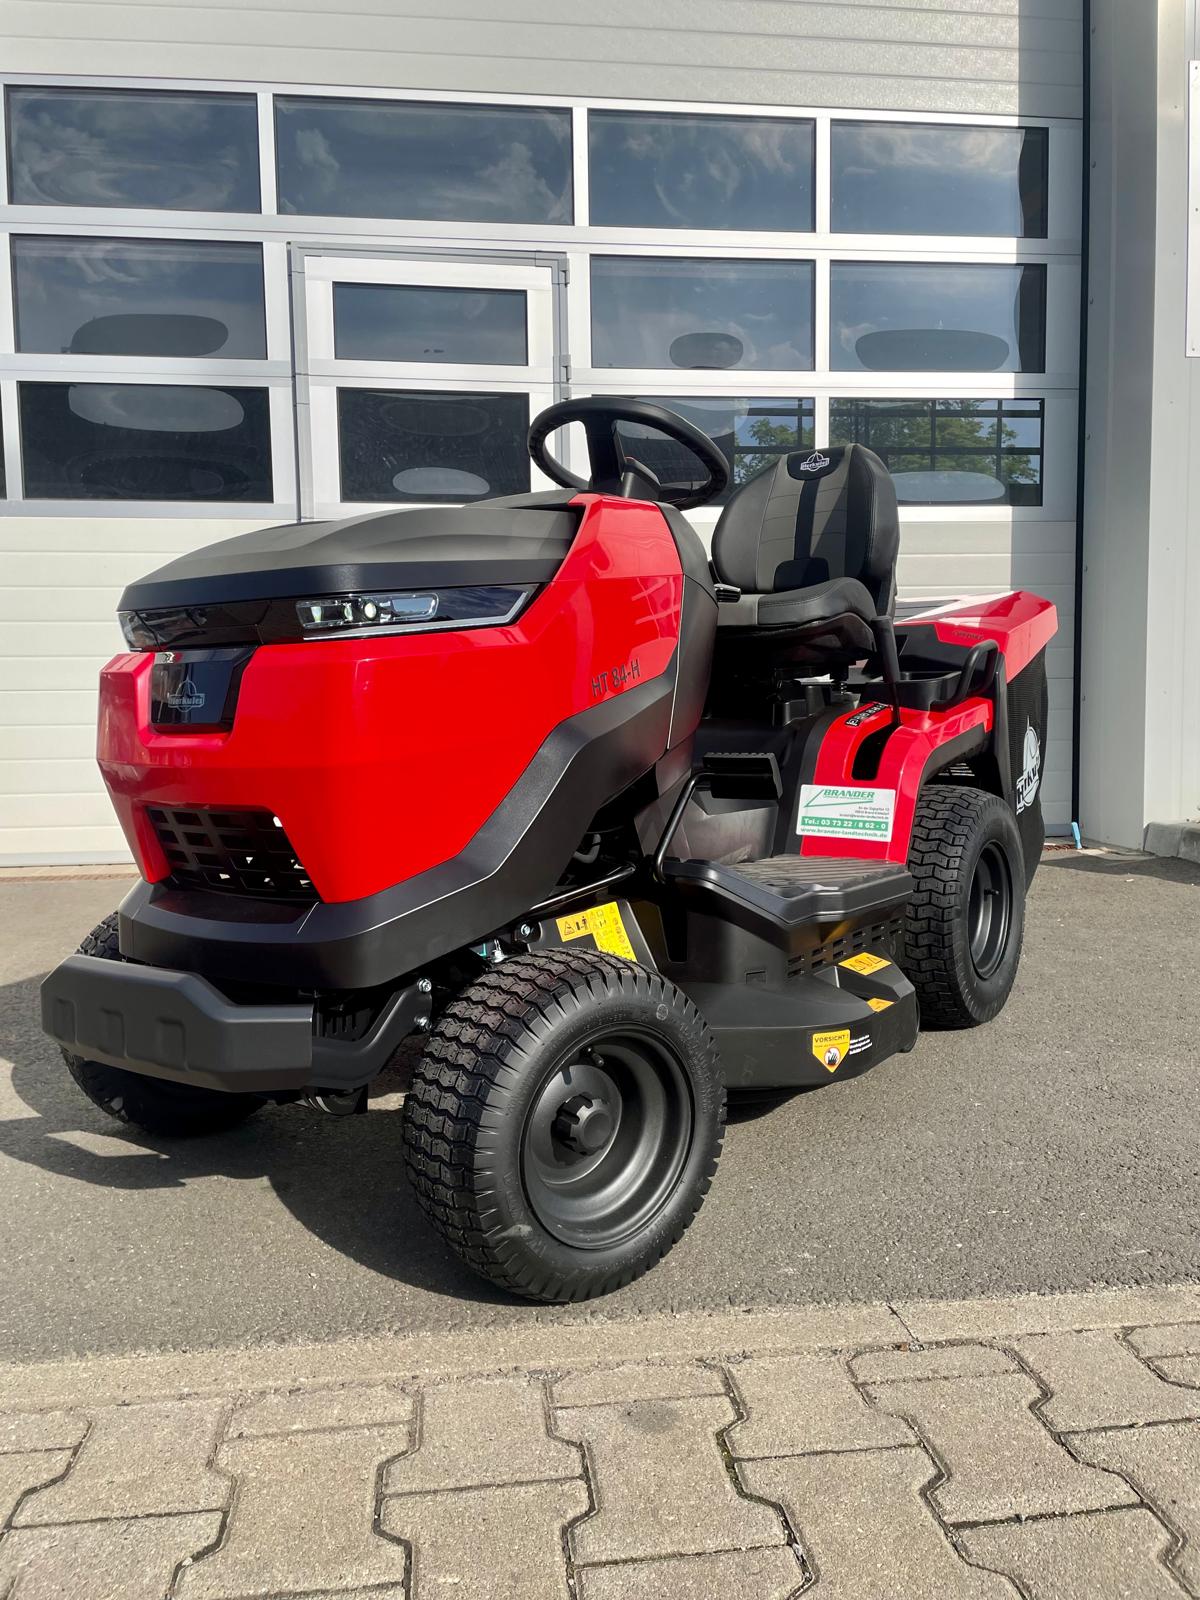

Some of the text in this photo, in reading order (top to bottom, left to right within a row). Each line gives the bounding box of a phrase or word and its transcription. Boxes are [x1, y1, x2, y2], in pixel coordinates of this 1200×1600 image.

[591, 658, 640, 698] HT 84-H
[823, 788, 875, 799] BRANDER
[804, 817, 819, 825] Tel.:
[815, 1035, 845, 1043] VORSICHT
